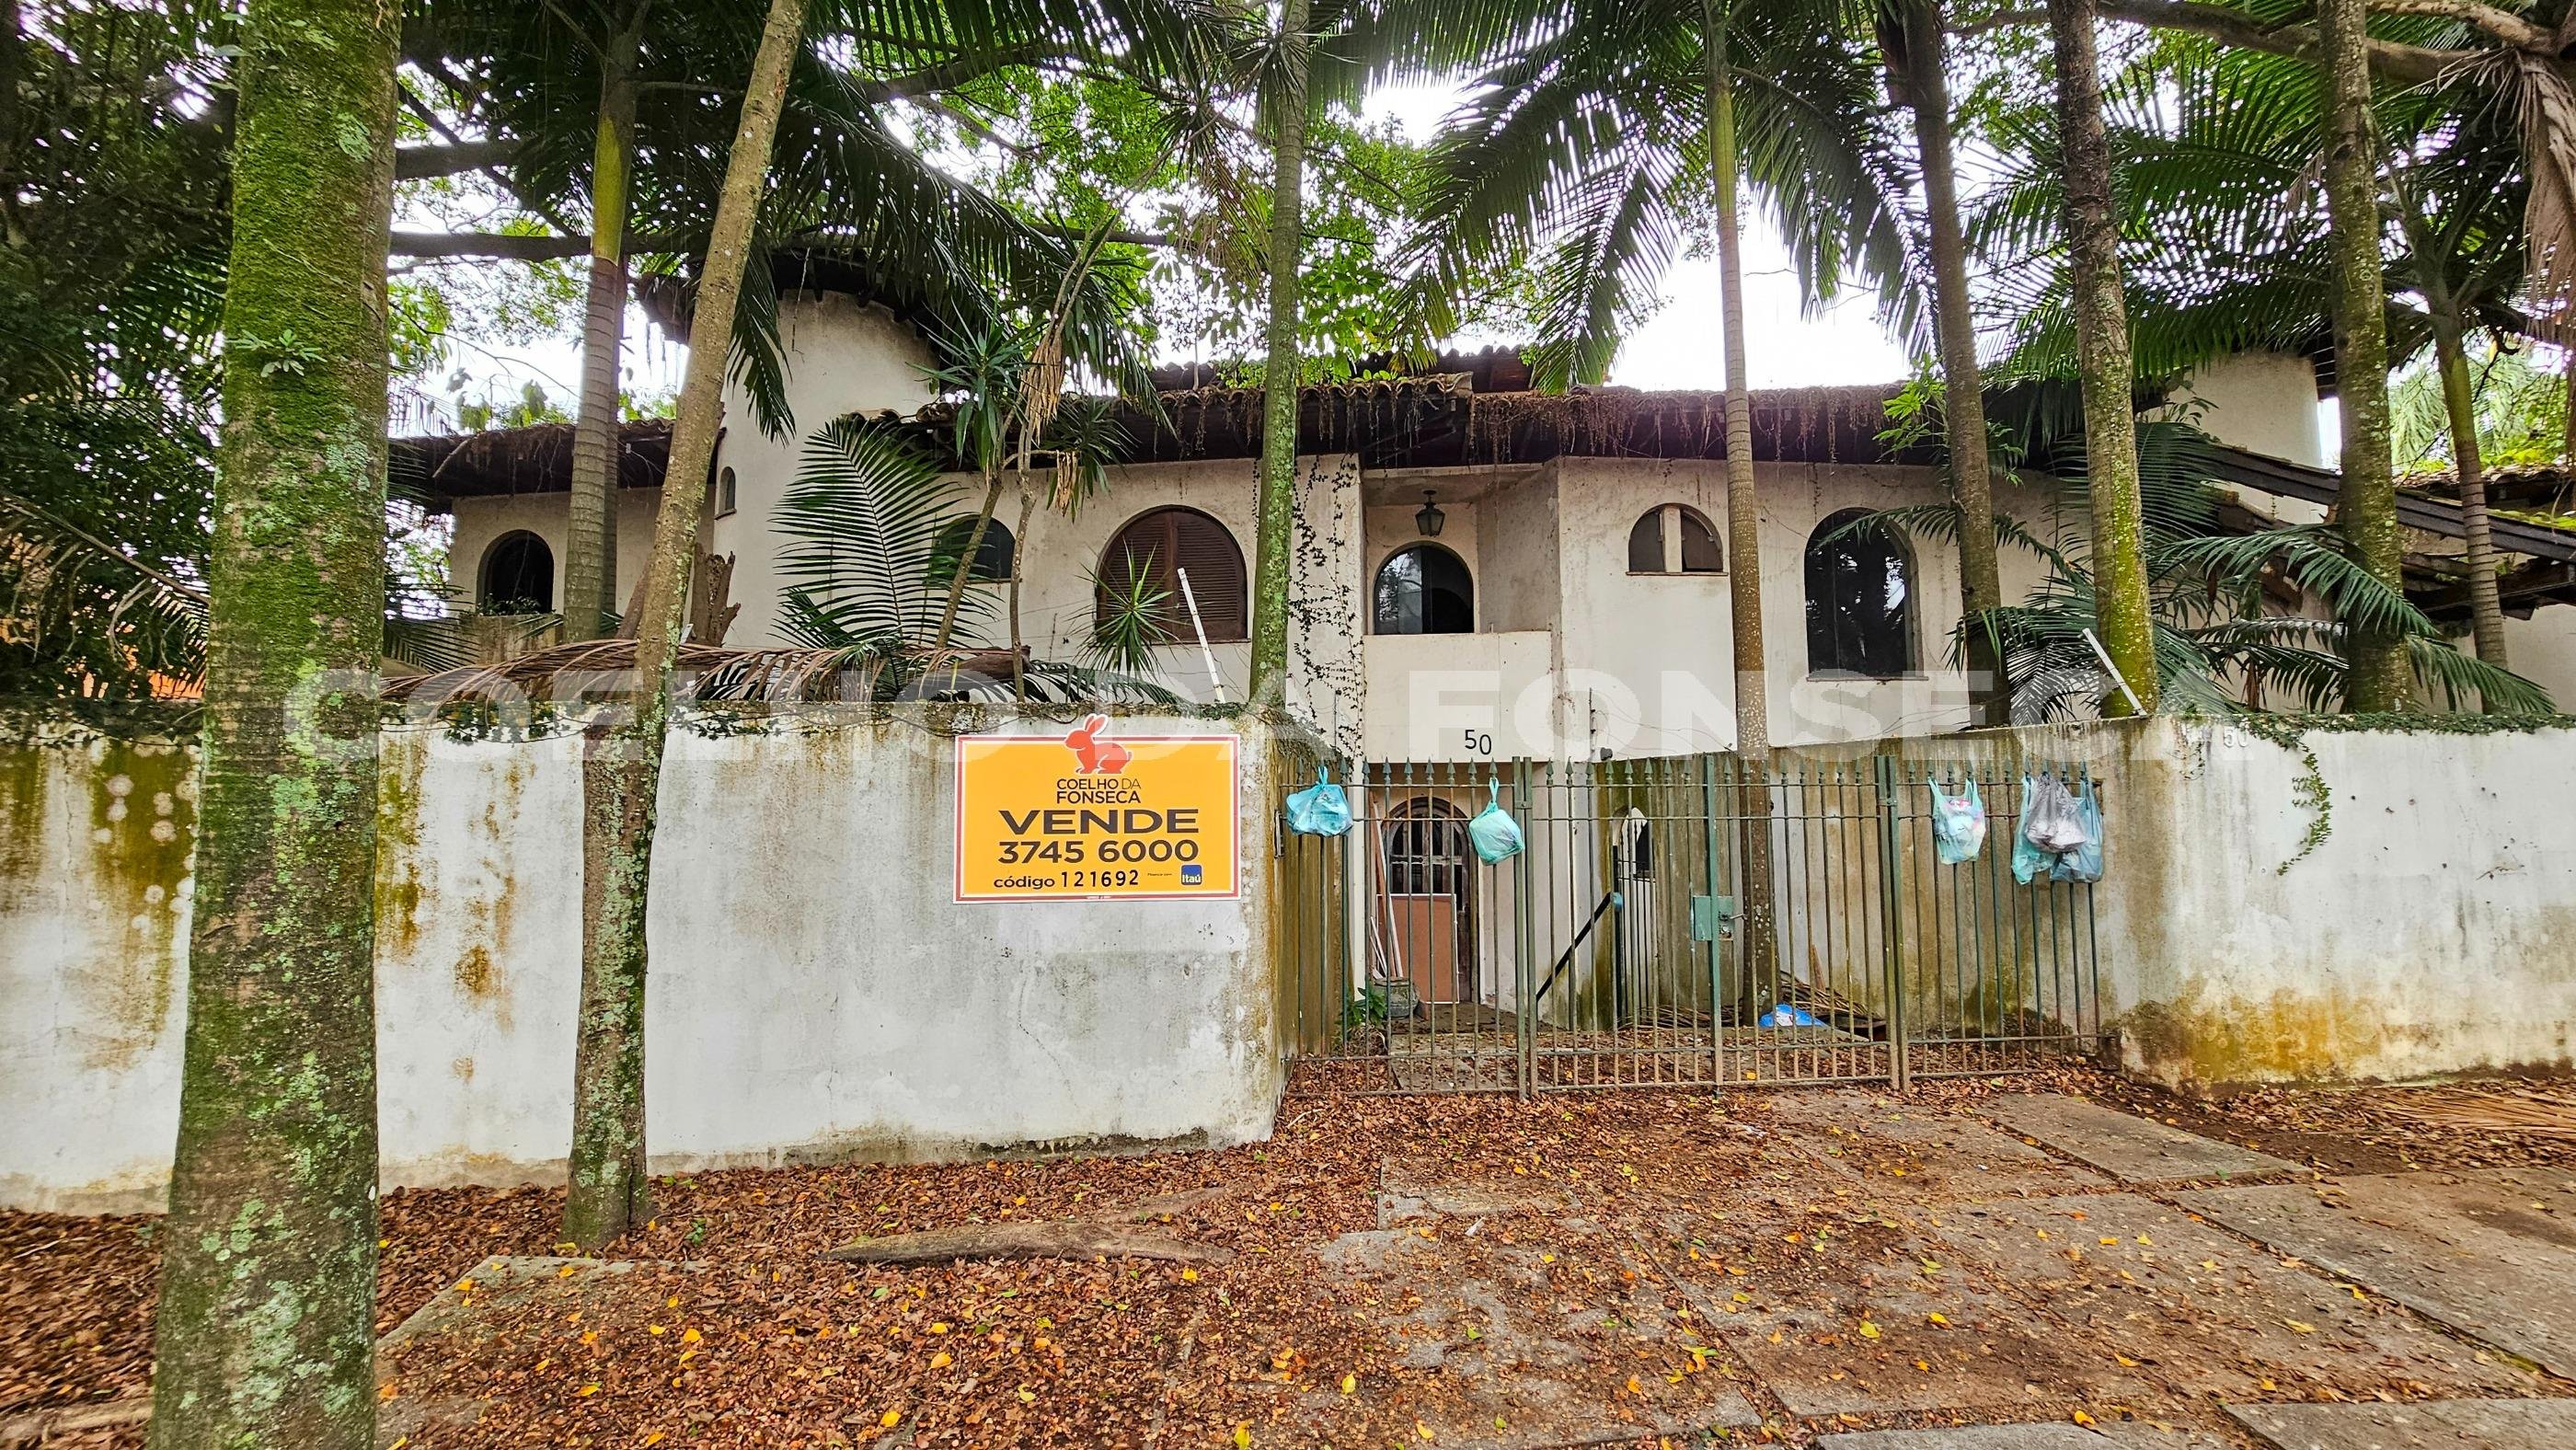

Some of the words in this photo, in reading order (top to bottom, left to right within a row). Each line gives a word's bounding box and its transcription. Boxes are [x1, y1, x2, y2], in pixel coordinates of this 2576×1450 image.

[1465, 729, 1492, 755] 50
[2223, 725, 2249, 748] 50
[1056, 777, 1119, 790] COELHO
[1121, 777, 1142, 789] DA
[1056, 790, 1142, 804] FONSECA
[998, 809, 1199, 834] VENDE
[998, 840, 1085, 864] 3745
[1098, 839, 1199, 863] 6000
[994, 874, 1055, 890] código
[1061, 869, 1139, 888] 121692
[1181, 873, 1202, 883] Itaú
